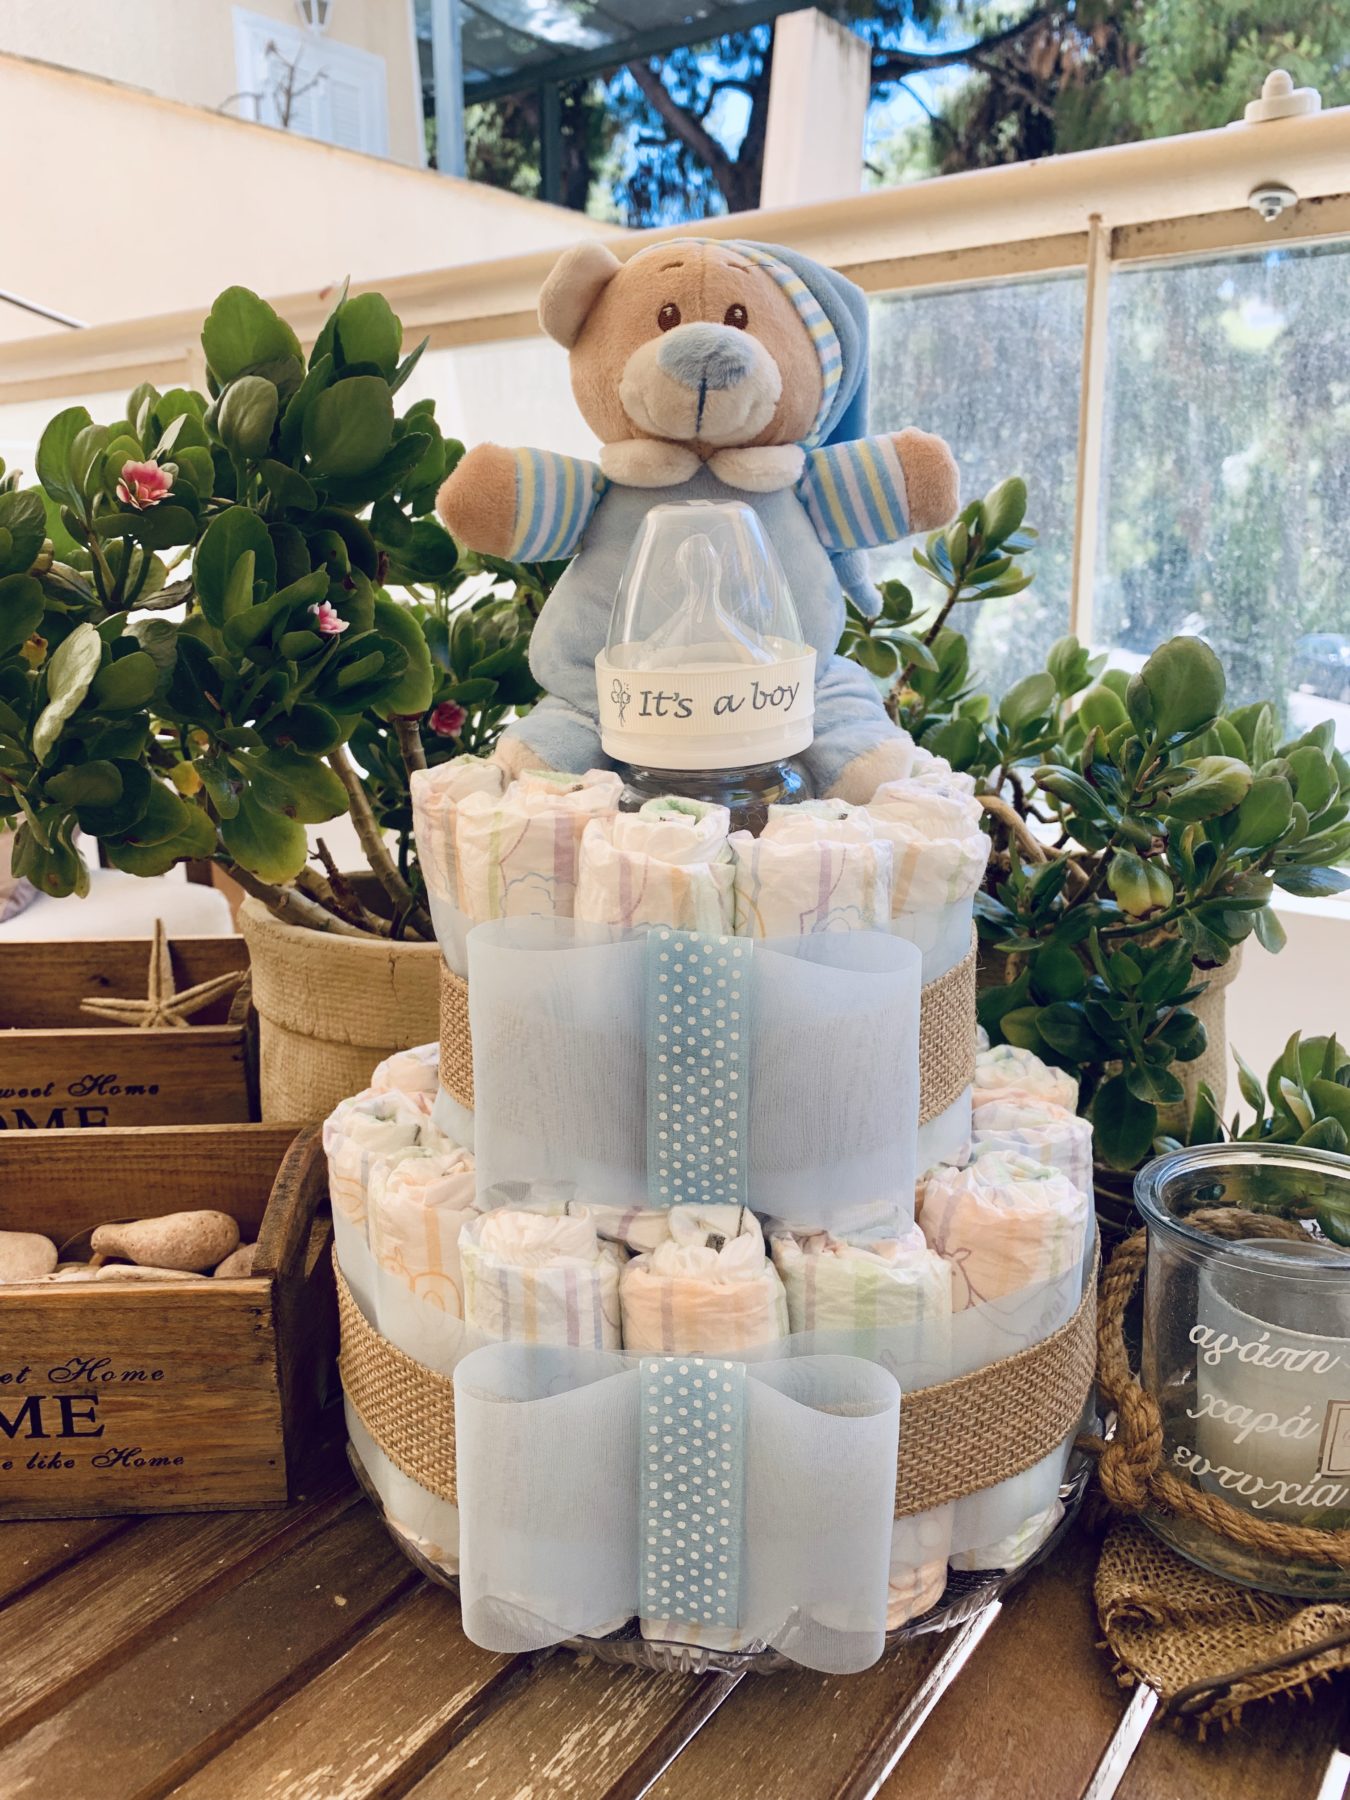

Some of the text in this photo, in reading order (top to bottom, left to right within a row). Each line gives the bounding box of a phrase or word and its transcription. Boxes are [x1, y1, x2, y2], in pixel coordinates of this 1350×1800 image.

[638, 681, 800, 719] It's a boy
[67, 1074, 160, 1098] Home
[0, 1106, 109, 1129] ME
[1189, 1324, 1341, 1374] αγάπη
[48, 1357, 165, 1384] Home
[1186, 1393, 1320, 1444] χαρά
[26, 1452, 75, 1470] like
[91, 1447, 184, 1469] Home
[1173, 1446, 1350, 1509] ευτυχία
